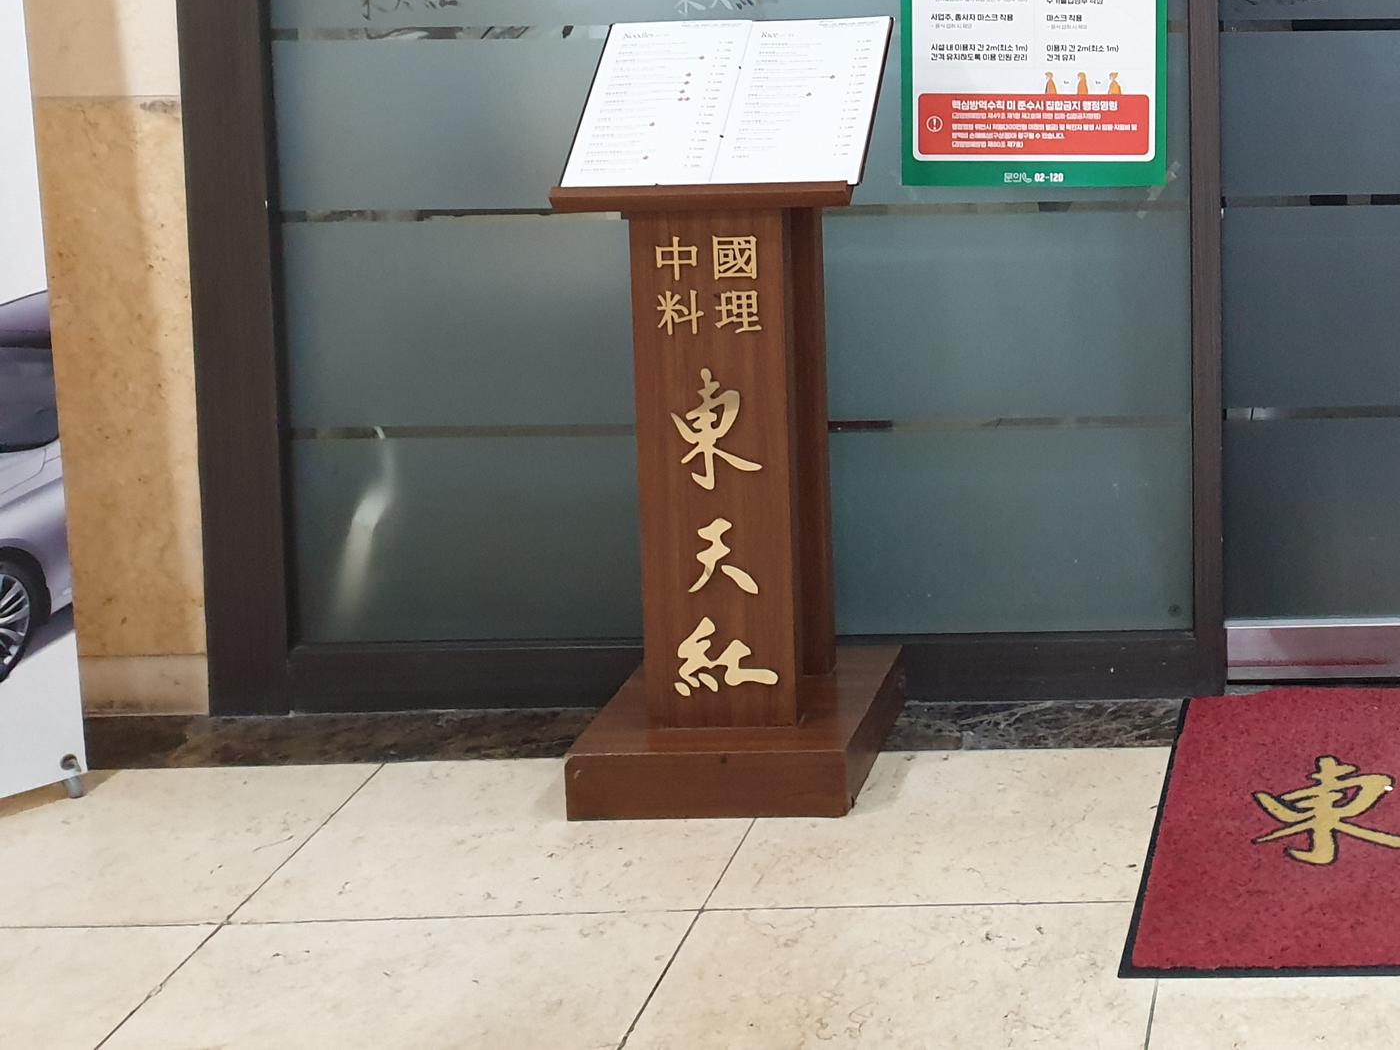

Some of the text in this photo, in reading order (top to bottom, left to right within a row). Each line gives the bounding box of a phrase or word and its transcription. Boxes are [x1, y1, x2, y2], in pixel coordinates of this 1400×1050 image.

[977, 13, 998, 22] 마스크
[1000, 13, 1014, 22] 착용
[1046, 14, 1083, 22] 마스크 착용
[930, 43, 945, 51] 시설
[946, 43, 953, 51] 내
[954, 43, 976, 51] 이용자
[977, 43, 985, 52] 간
[1015, 43, 1028, 52] 1m)
[1046, 44, 1067, 52] 이용자
[1068, 44, 1076, 52] 간
[1106, 44, 1119, 53] 1m)
[930, 53, 1028, 61] 간격 유지하도록 이용 인원 관리
[1046, 54, 1076, 62] 간격 유지
[1006, 100, 1016, 110] 미
[1004, 172, 1064, 183] 문의 02-120
[655, 233, 758, 282] 中國
[656, 289, 763, 335] 料理
[670, 367, 778, 697] 東天紅
